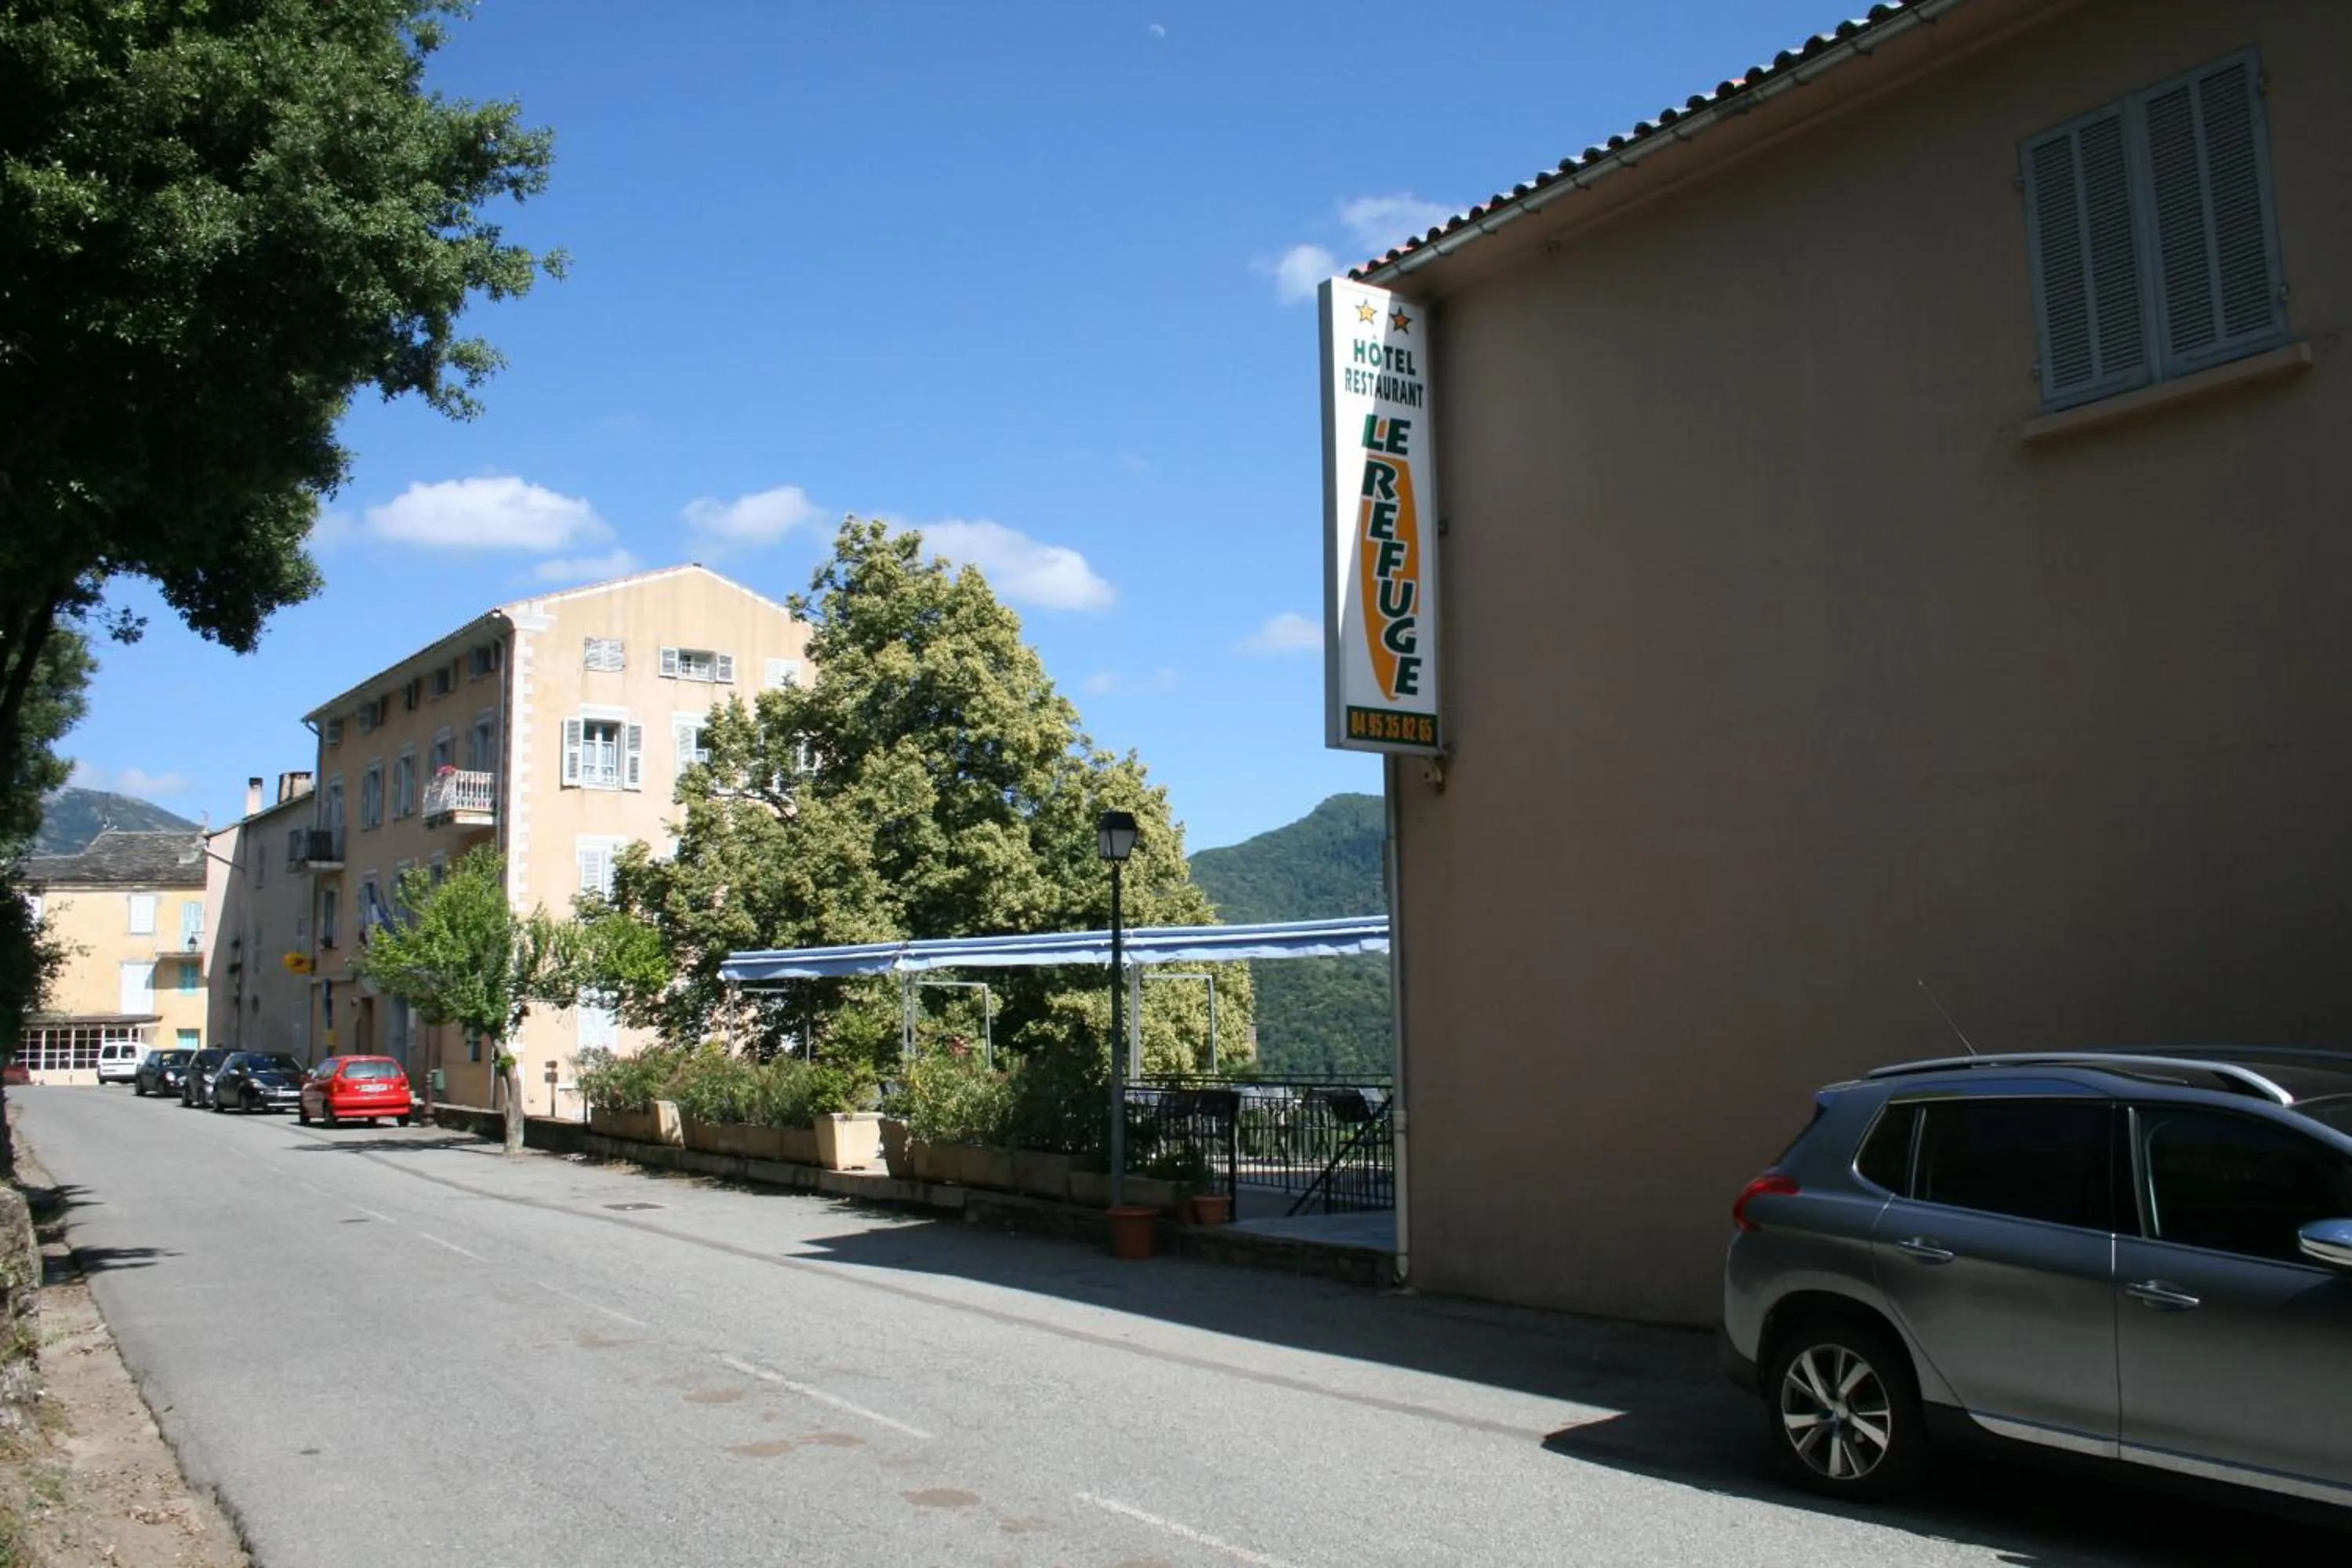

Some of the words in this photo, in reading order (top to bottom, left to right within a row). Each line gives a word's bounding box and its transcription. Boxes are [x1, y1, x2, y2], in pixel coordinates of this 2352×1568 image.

[1345, 367, 1425, 408] RESTAURANT
[1361, 413, 1412, 456] LE
[1361, 459, 1422, 696] REFUGE
[1368, 712, 1383, 738] 95
